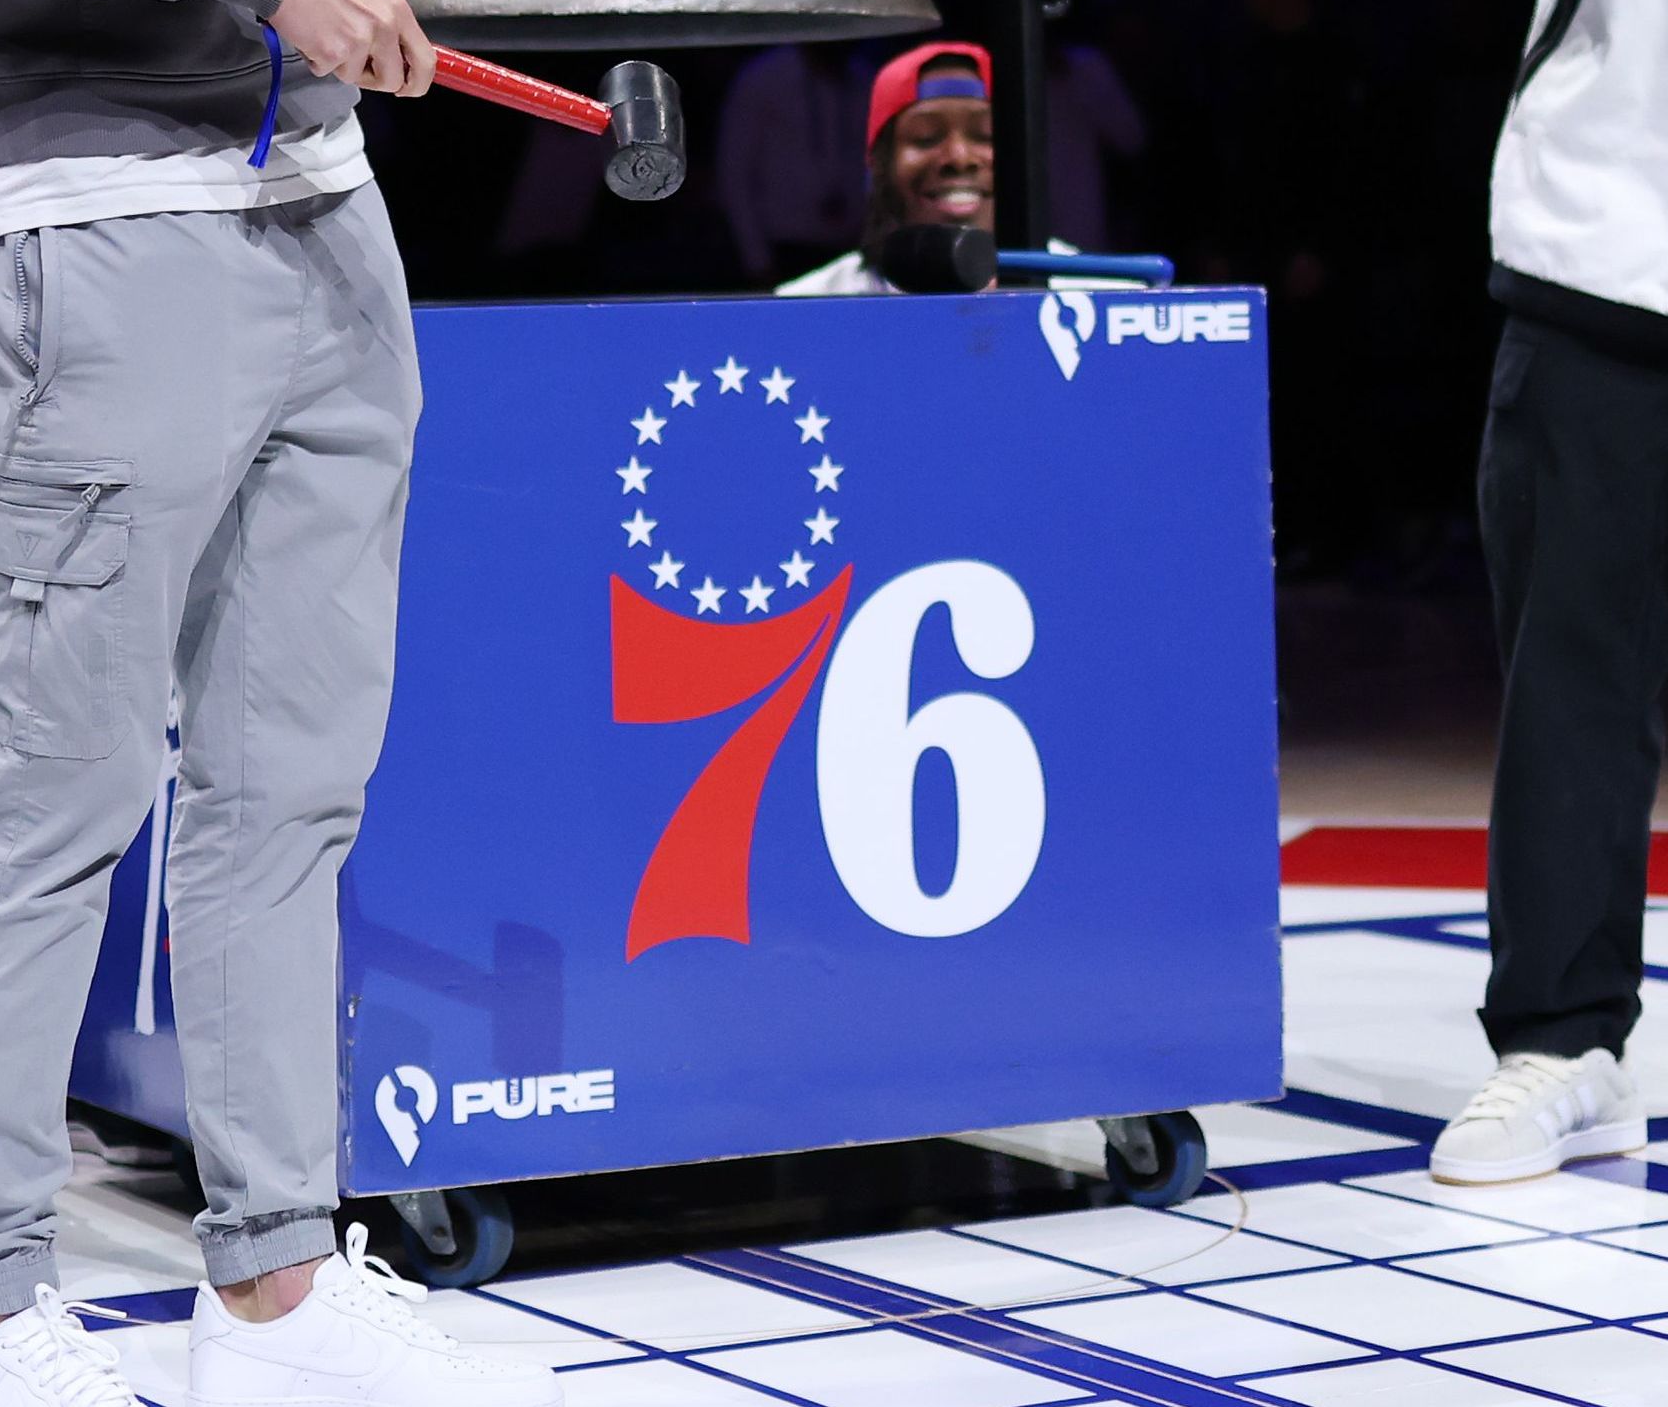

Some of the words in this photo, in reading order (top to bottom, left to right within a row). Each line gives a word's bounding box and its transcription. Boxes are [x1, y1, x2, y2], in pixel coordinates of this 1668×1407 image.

[1107, 301, 1250, 345] PURE
[610, 559, 1046, 964] 76
[452, 1069, 615, 1125] PURE
